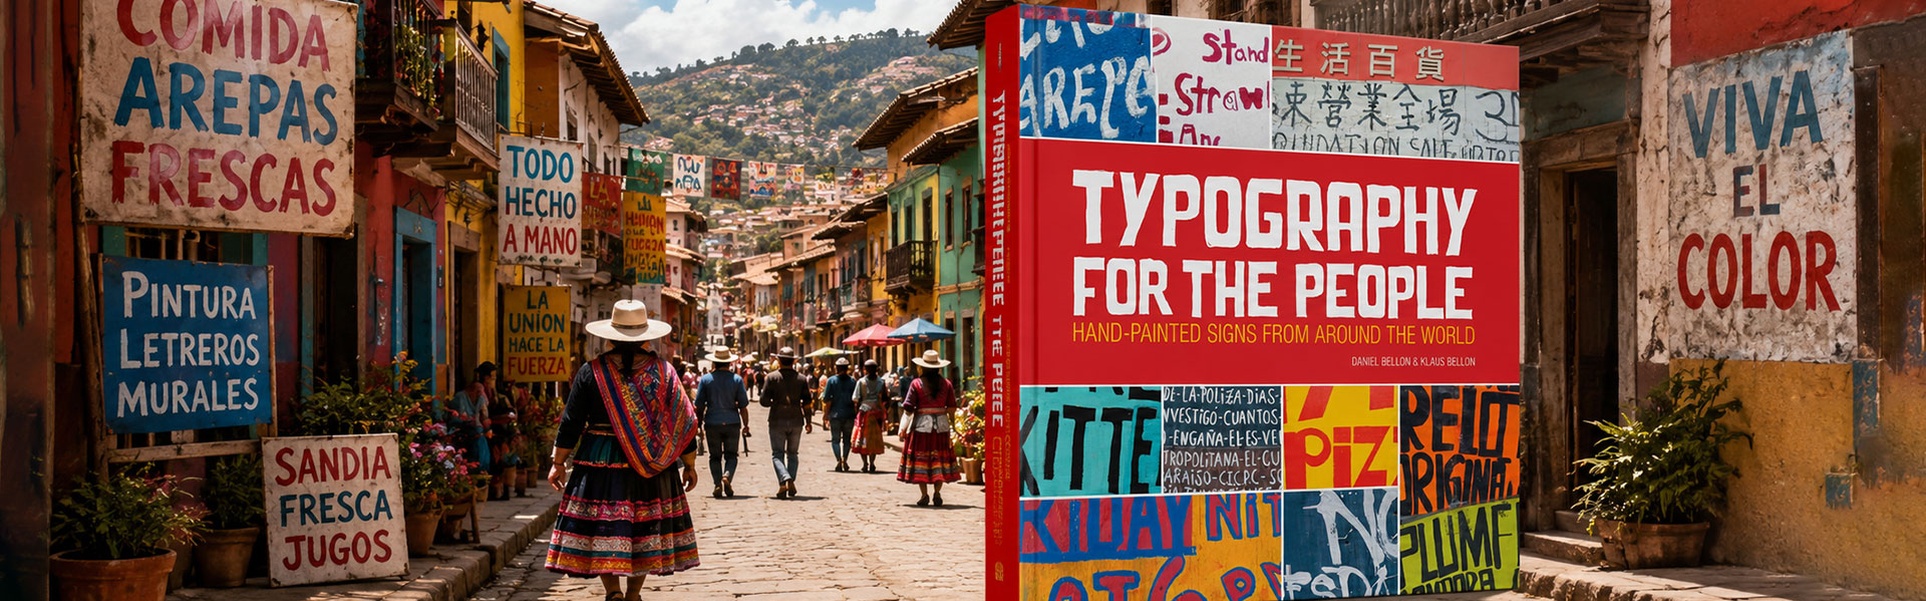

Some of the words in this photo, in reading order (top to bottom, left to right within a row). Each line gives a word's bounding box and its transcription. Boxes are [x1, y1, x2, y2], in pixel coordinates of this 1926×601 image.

[117, 0, 330, 72] COMIDA
[1202, 28, 1269, 65] Stand
[1272, 38, 1446, 82] 生活百貨
[113, 57, 338, 146] AREPAS
[1682, 69, 1823, 159] VIVA
[111, 140, 337, 217] FRESCAS
[506, 145, 574, 184] TODO
[505, 186, 577, 219] HECHO
[1732, 164, 1781, 218] EL
[1072, 169, 1478, 257] TYPOGRAPHY
[503, 223, 518, 253] A
[525, 224, 578, 255] MANO
[1072, 256, 1174, 317] FOR
[1182, 259, 1279, 318] THE
[1296, 262, 1474, 320] PEOPLE
[1677, 230, 1842, 313] COLOR
[122, 271, 257, 321] PINTURA
[527, 290, 549, 310] LA
[120, 328, 260, 369] LETREROS
[508, 336, 544, 353] HACE
[549, 337, 565, 353] LA
[1072, 322, 1201, 343] HAND-PAINTED
[1207, 323, 1257, 344] SIGNS
[1263, 323, 1309, 344] FROM
[1314, 324, 1381, 344] AROUND
[1386, 325, 1416, 345] THE
[1421, 325, 1476, 345] WORLD
[508, 356, 567, 376] FUERZA
[1351, 356, 1379, 367] DANIEL
[1381, 356, 1411, 367] BELLON
[1413, 357, 1419, 367] &
[1420, 357, 1446, 367] KLAUS
[1447, 357, 1476, 367] BELLON
[117, 377, 259, 418] MURALES
[275, 446, 392, 487] SANDIA
[1020, 404, 1162, 496] KITTE
[279, 489, 394, 527] FRESCA
[283, 529, 392, 572] JUGOS
